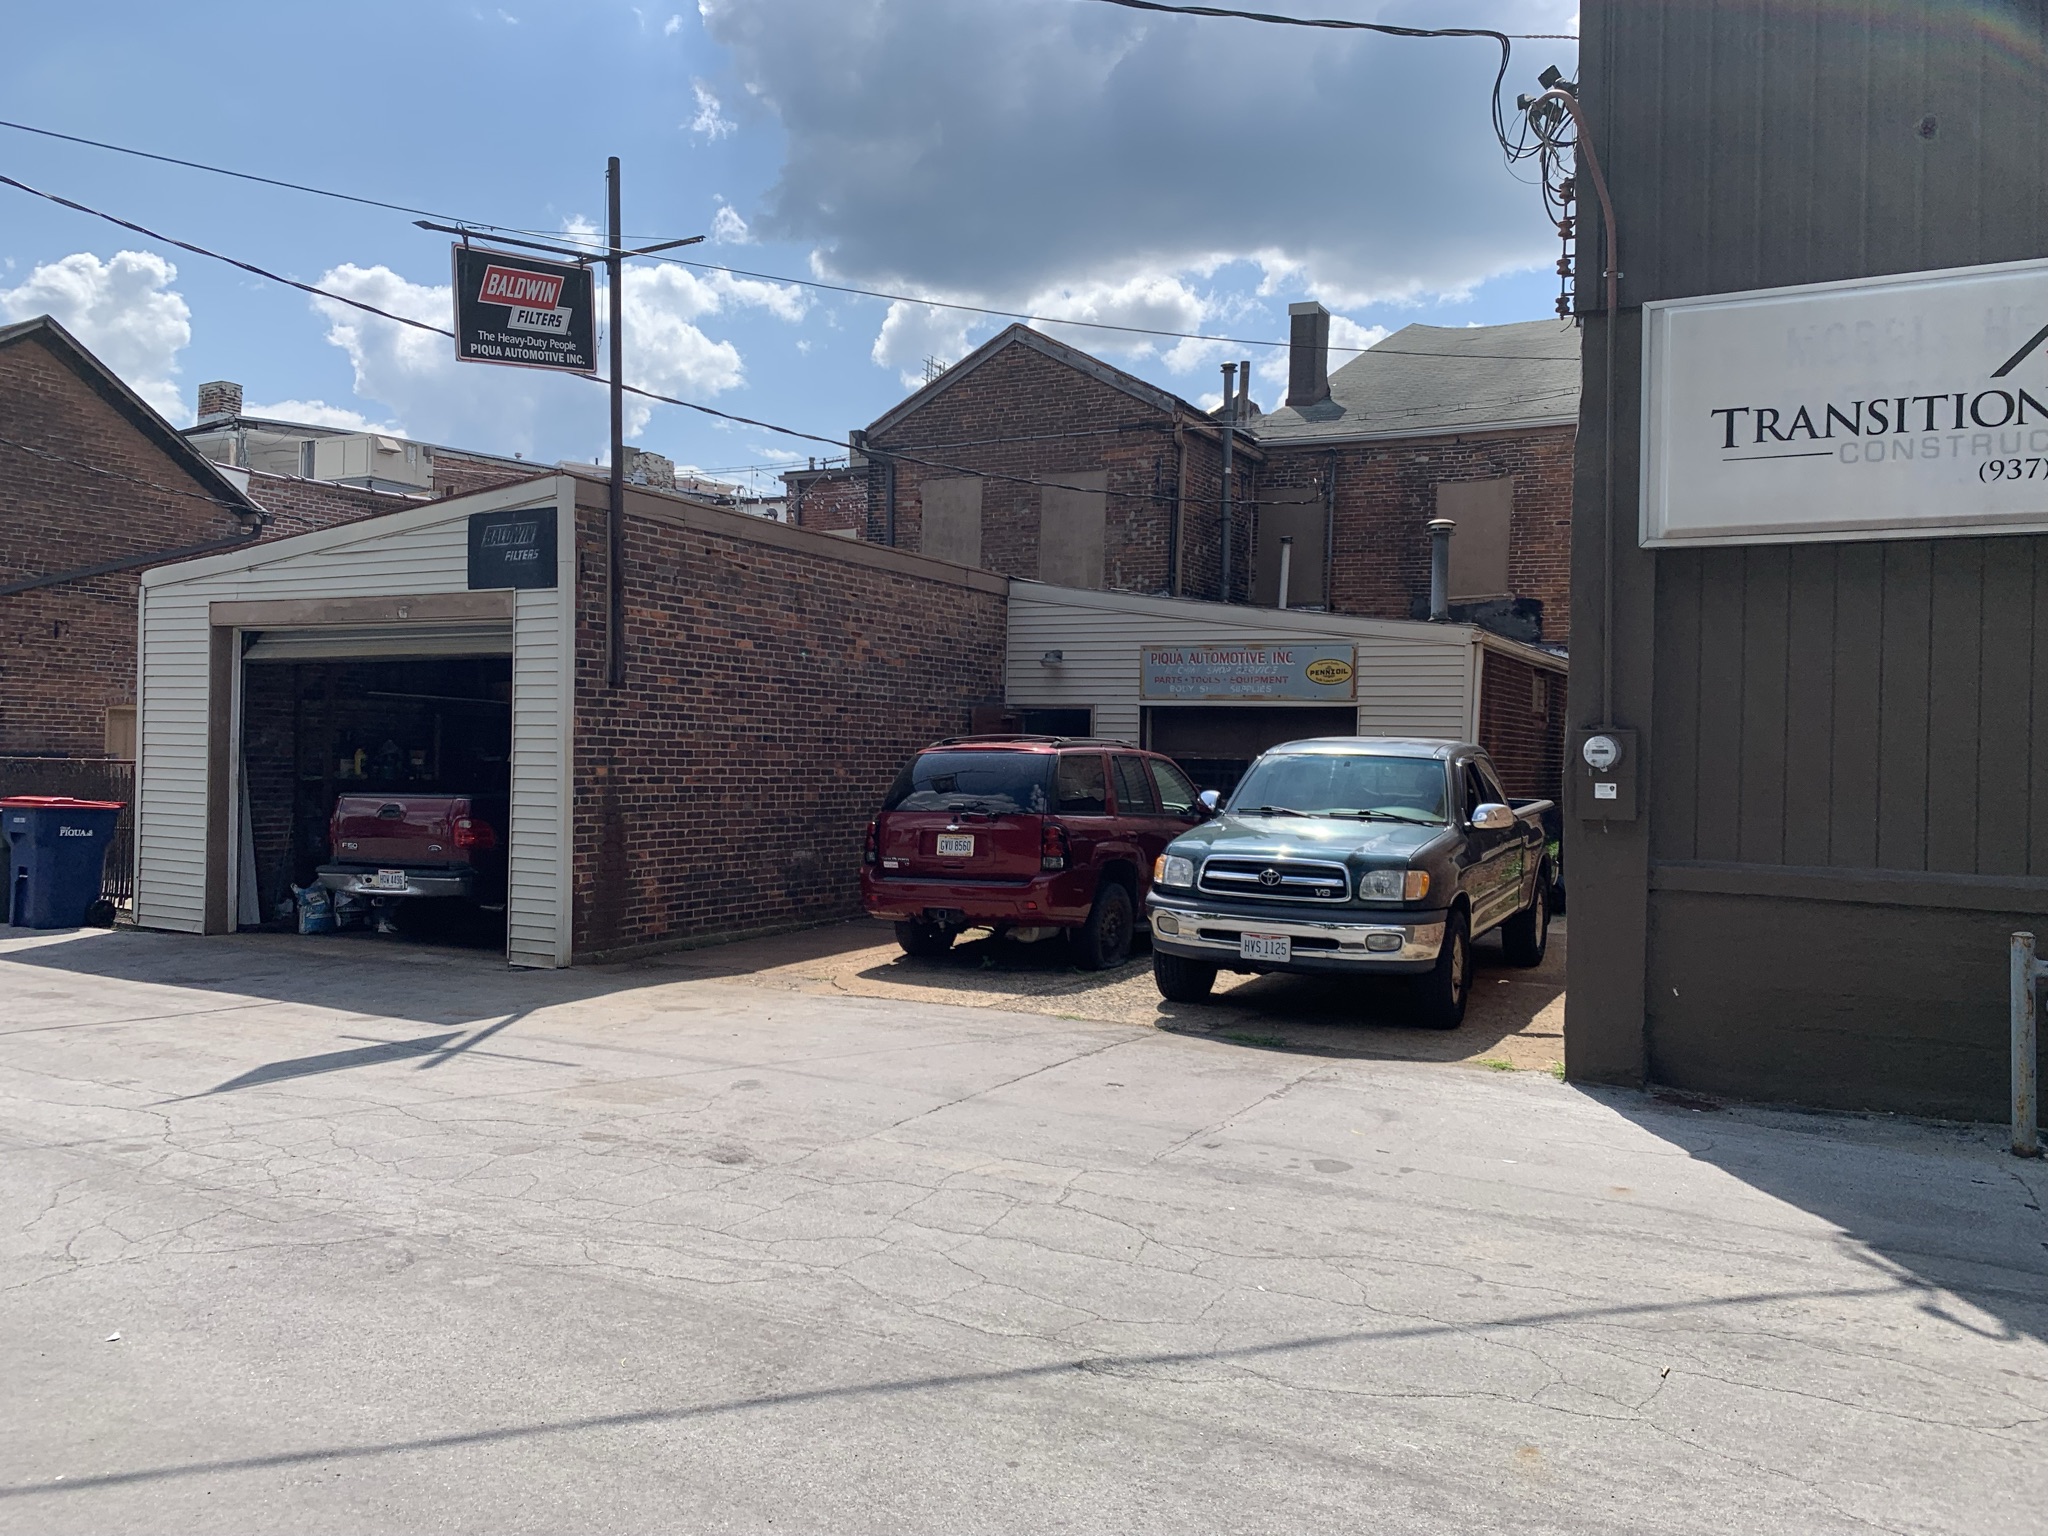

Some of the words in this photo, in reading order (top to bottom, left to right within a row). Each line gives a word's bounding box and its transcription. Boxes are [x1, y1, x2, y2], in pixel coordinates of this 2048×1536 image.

[487, 273, 557, 303] BALDWIN
[517, 310, 562, 327] FILTERS
[478, 330, 495, 341] The
[498, 333, 547, 350] Heavy-Duty
[550, 339, 576, 352] People
[470, 343, 502, 356] PIQUA
[504, 348, 565, 363] AUTOMOTIVE
[566, 355, 586, 365] INC.
[1710, 386, 2048, 449] TRANSITION
[1839, 428, 2048, 464] CONSTRUC
[504, 549, 539, 561] FILTERS
[1150, 651, 1184, 665] PIQUA
[1154, 676, 1183, 684] PARTS
[1190, 676, 1221, 684] TOOLS
[1229, 676, 1289, 684] EQUIPMENT
[1230, 685, 1272, 693] SUPPLIES
[59, 829, 86, 837] PIQUA
[940, 840, 953, 850] GVU
[954, 840, 971, 851] 8560
[1315, 889, 1330, 897] V8
[1244, 939, 1261, 953] HVS
[1264, 941, 1287, 956] 1125
